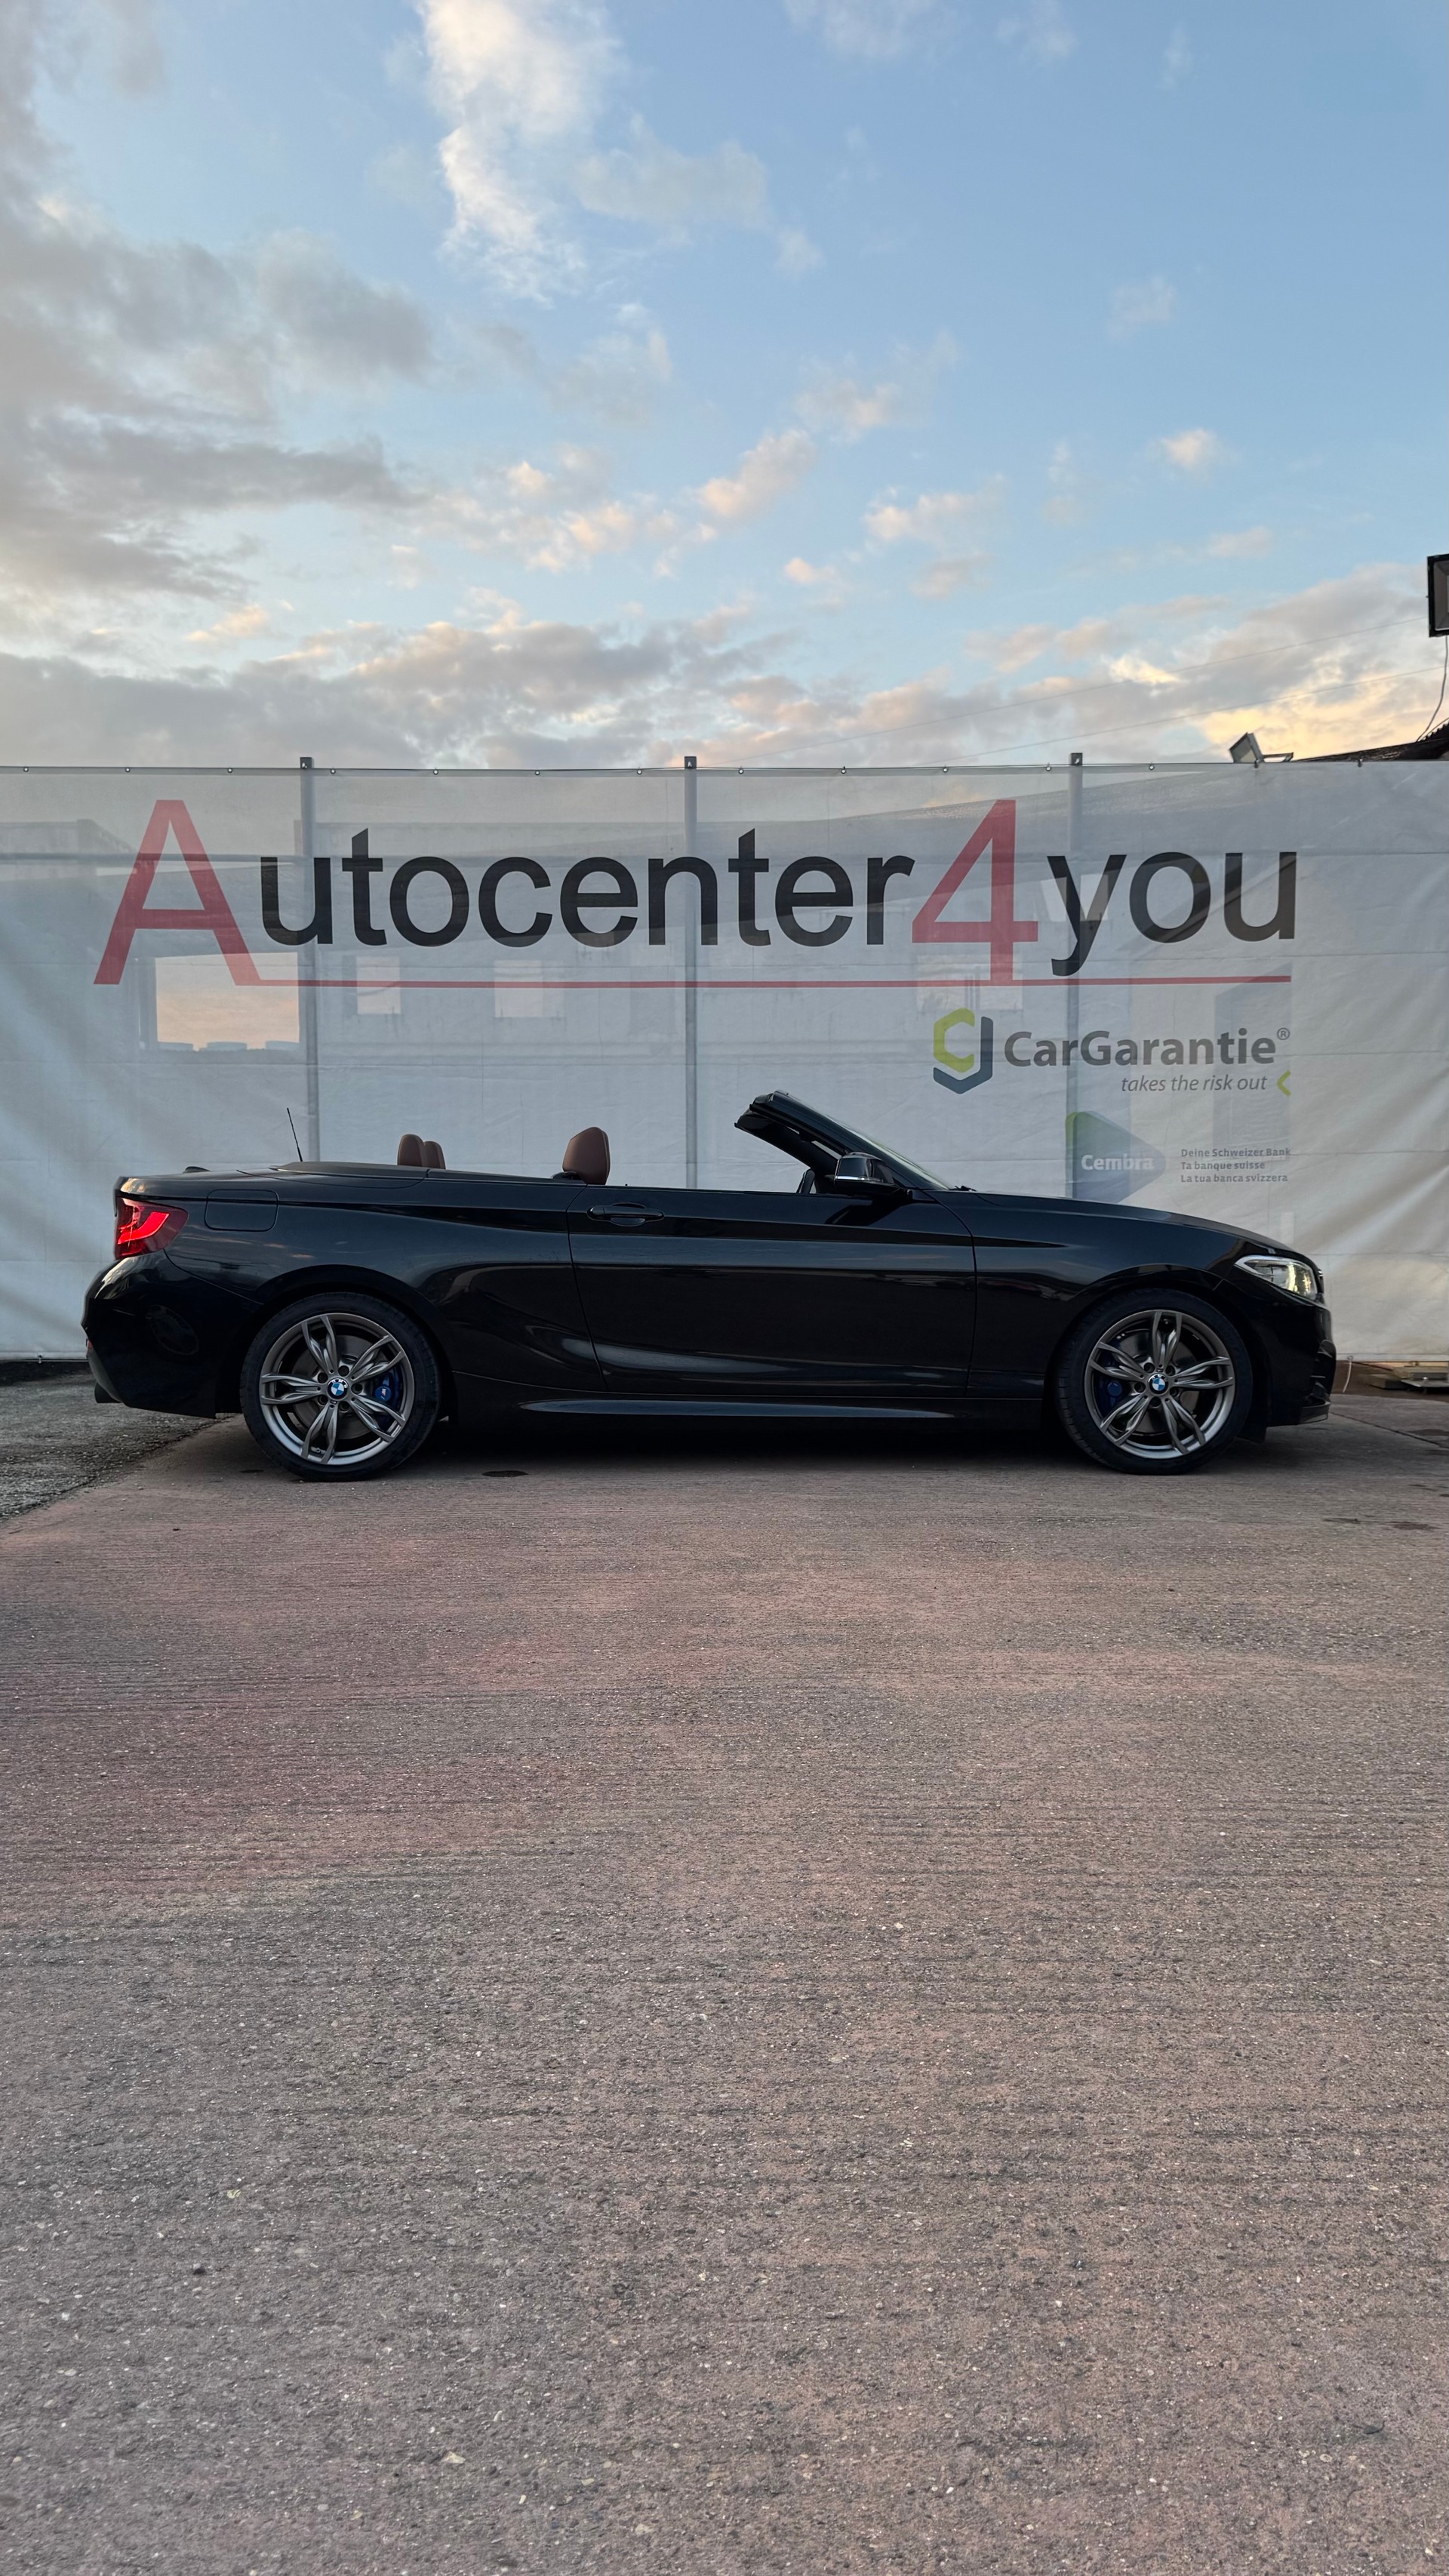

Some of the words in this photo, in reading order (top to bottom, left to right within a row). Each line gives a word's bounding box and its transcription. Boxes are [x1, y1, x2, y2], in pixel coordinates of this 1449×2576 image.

[93, 799, 1298, 985] Autocenter4you
[1121, 1075, 1167, 1092] takes
[1171, 1075, 1199, 1091] the
[1202, 1074, 1233, 1091] risk
[1237, 1076, 1268, 1091] out
[1181, 1148, 1210, 1157] Deine
[1211, 1148, 1264, 1157] Schweizer
[1266, 1147, 1291, 1157] Bank
[1081, 1153, 1155, 1171] Cembra
[1181, 1162, 1192, 1170] Ta
[1194, 1161, 1232, 1172] banque
[1234, 1161, 1266, 1170] suisse
[1181, 1174, 1192, 1183] La
[1214, 1174, 1244, 1183] banca
[1245, 1174, 1288, 1183] svizzera
